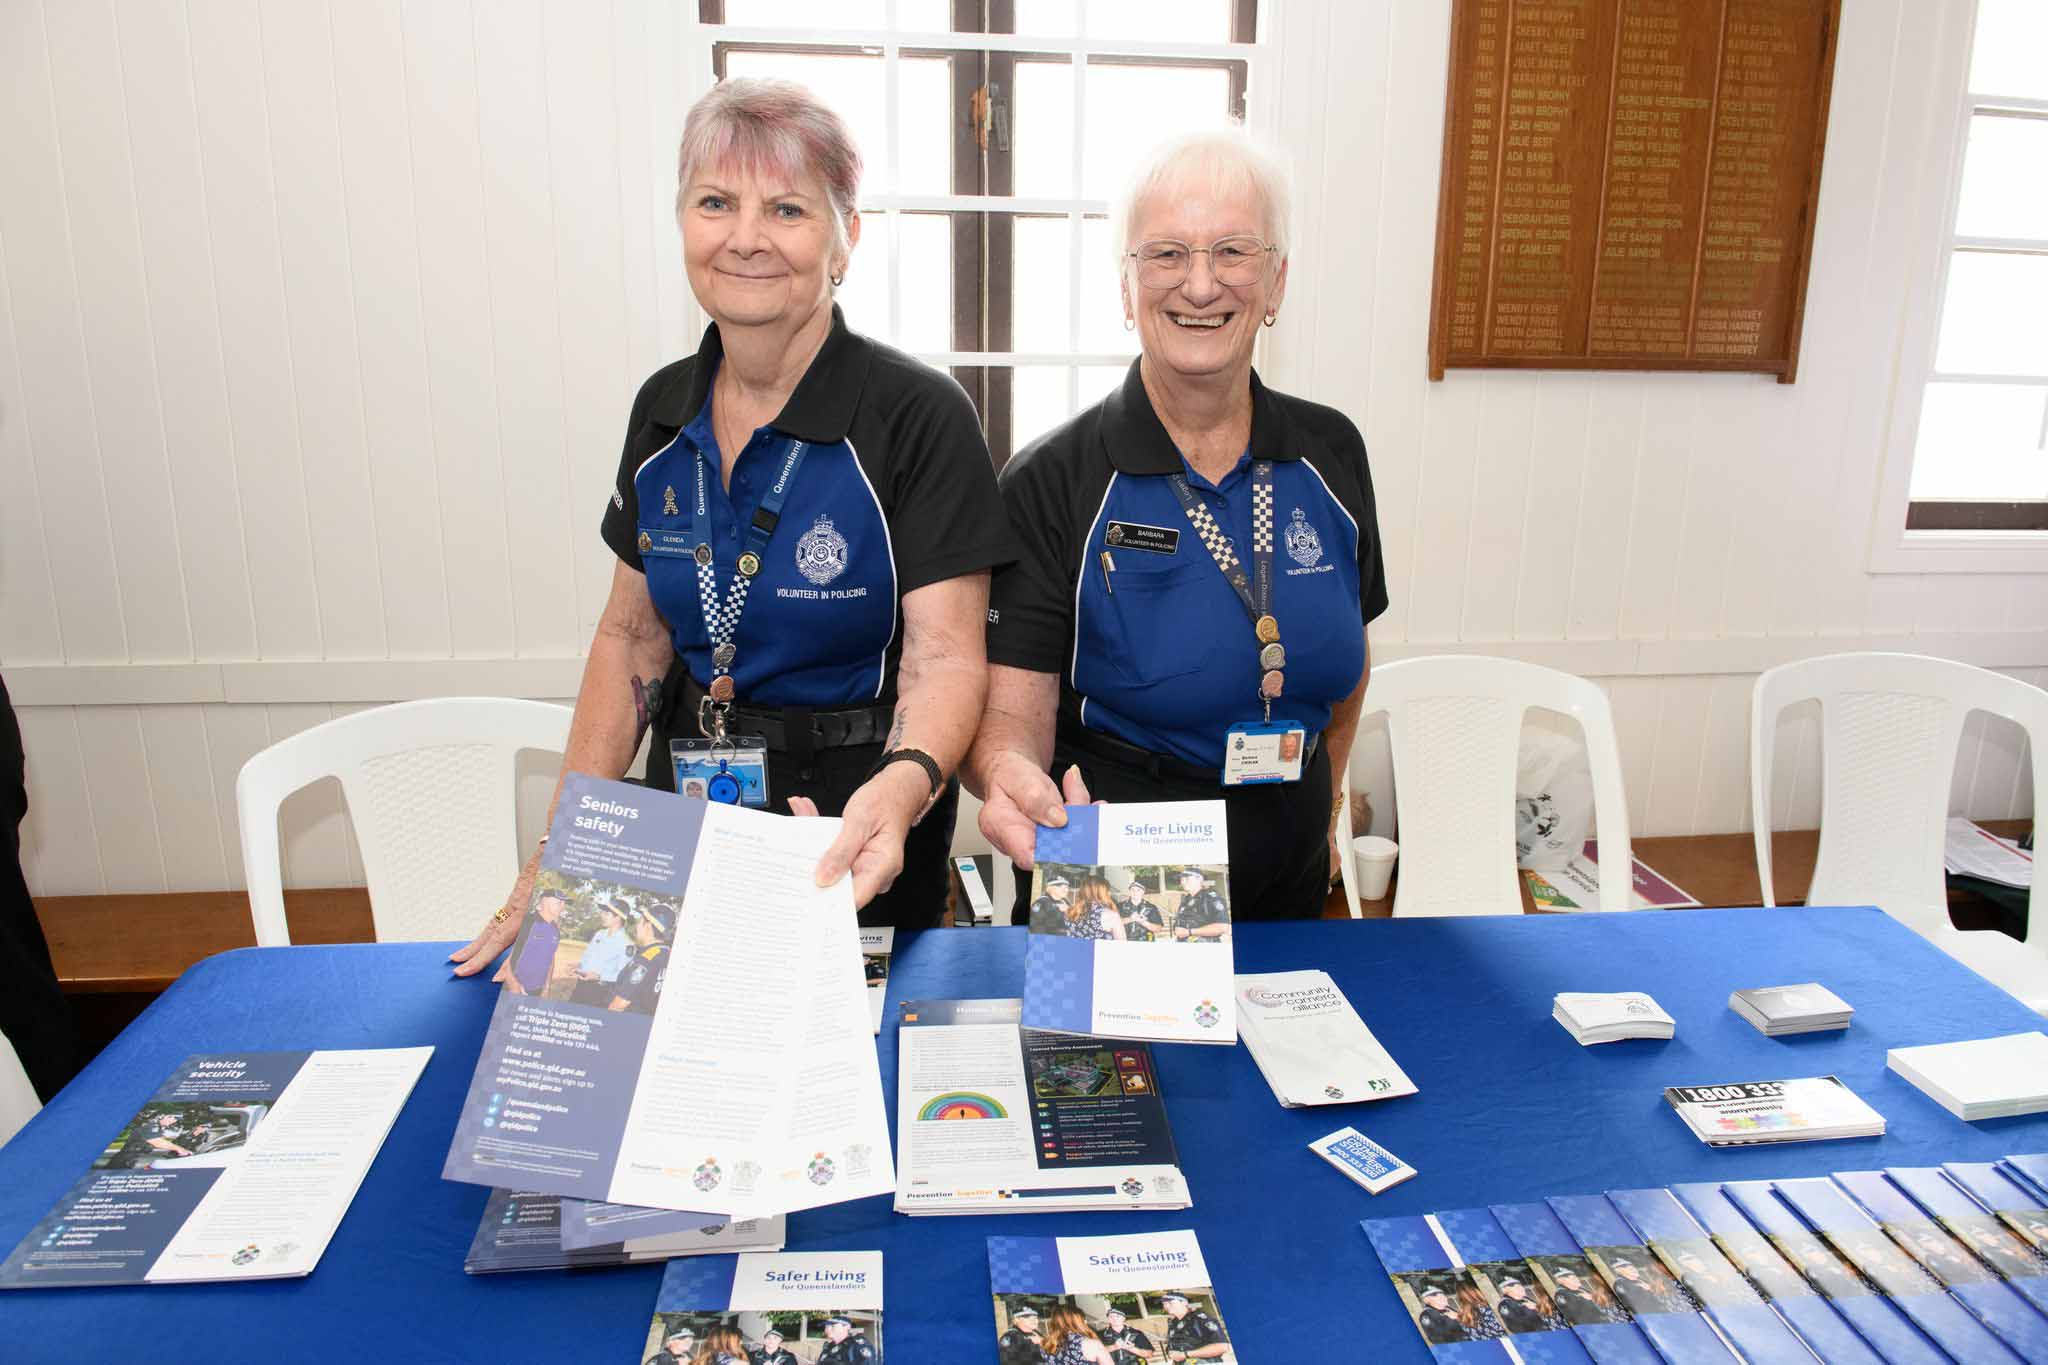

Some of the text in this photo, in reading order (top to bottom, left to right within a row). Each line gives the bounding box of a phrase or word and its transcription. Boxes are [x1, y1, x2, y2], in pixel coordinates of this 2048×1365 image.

[774, 440, 802, 494] Queensland
[697, 461, 705, 516] Queensland
[1137, 530, 1165, 538] BARBARA
[776, 587, 867, 600] VOLUNTEER IN POLICING
[580, 795, 640, 820] Seniors
[574, 814, 625, 838] safety
[1124, 821, 1213, 836] Safer Living
[1261, 986, 1330, 999] Community
[1286, 993, 1336, 1005] camera
[1293, 1000, 1341, 1011] alliance
[528, 1015, 549, 1027] Triple
[550, 1019, 568, 1029] Zero
[550, 1028, 587, 1041] Policelink
[505, 1045, 522, 1055] Find
[523, 1048, 532, 1056] us
[198, 1060, 247, 1070] Vehicle
[502, 1058, 586, 1077] www.police.qld.gov.au
[189, 1069, 246, 1079] security
[1686, 1086, 1745, 1102] 1800
[1720, 1105, 1783, 1115] anonymously
[1346, 1137, 1378, 1160] CRIME
[1339, 1140, 1388, 1174] STOPPERS
[907, 1191, 953, 1199] Prevention
[1089, 1249, 1188, 1267] Safer Living
[1123, 1262, 1190, 1273] Queenslanders
[765, 1270, 866, 1283] Safer Living
